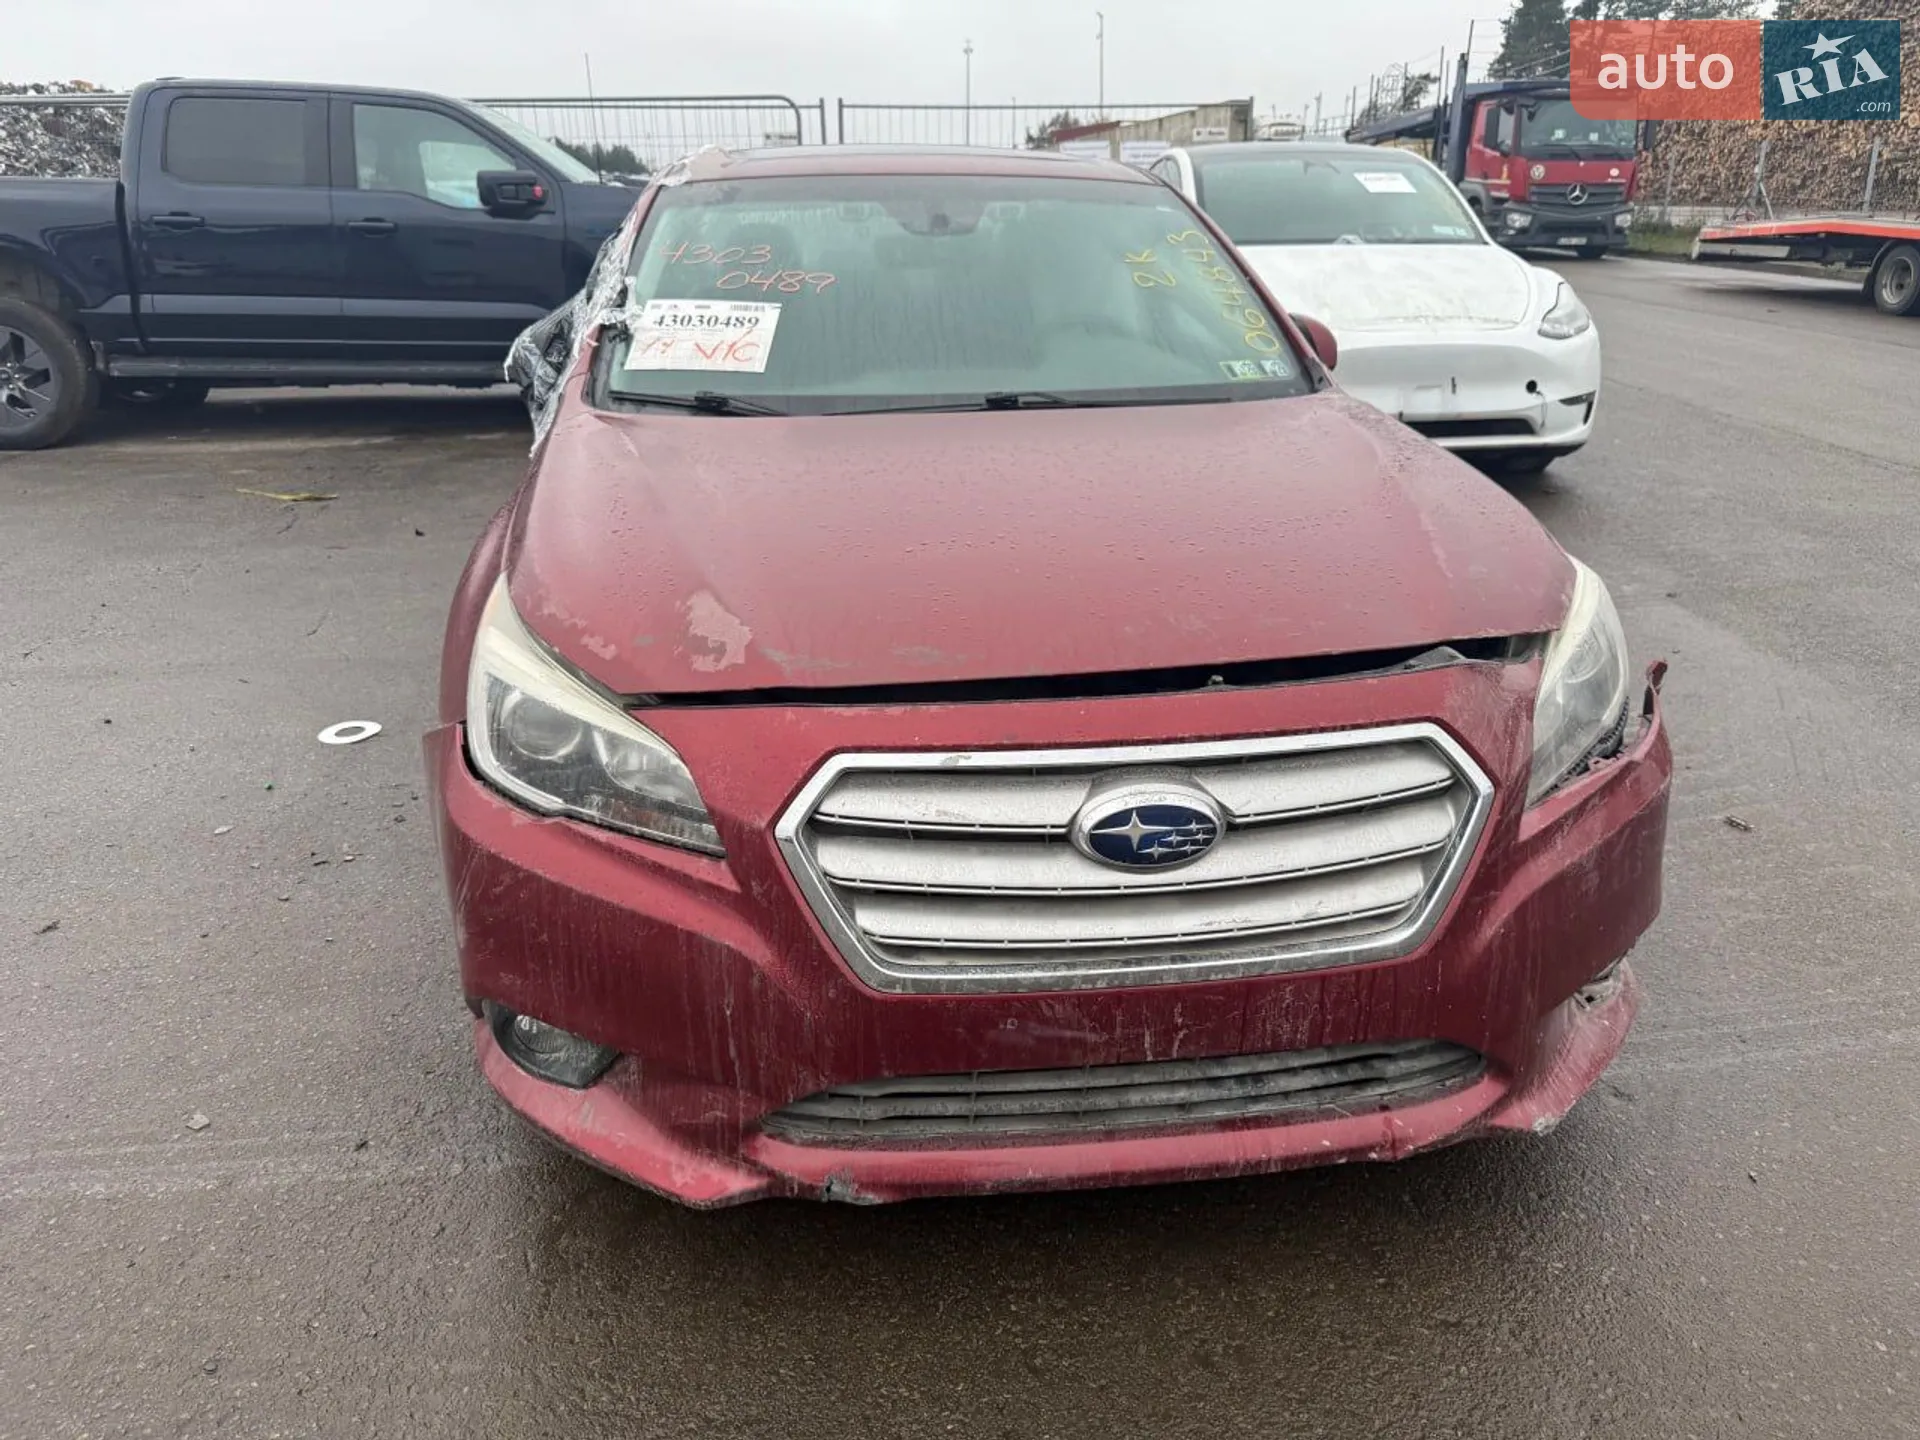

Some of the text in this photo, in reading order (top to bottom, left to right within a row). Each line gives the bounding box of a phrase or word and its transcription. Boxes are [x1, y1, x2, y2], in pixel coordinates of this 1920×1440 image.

[660, 242, 772, 264] 4303
[716, 271, 838, 293] 0489
[1166, 230, 1281, 353] 064843
[653, 314, 760, 329] 43030489
